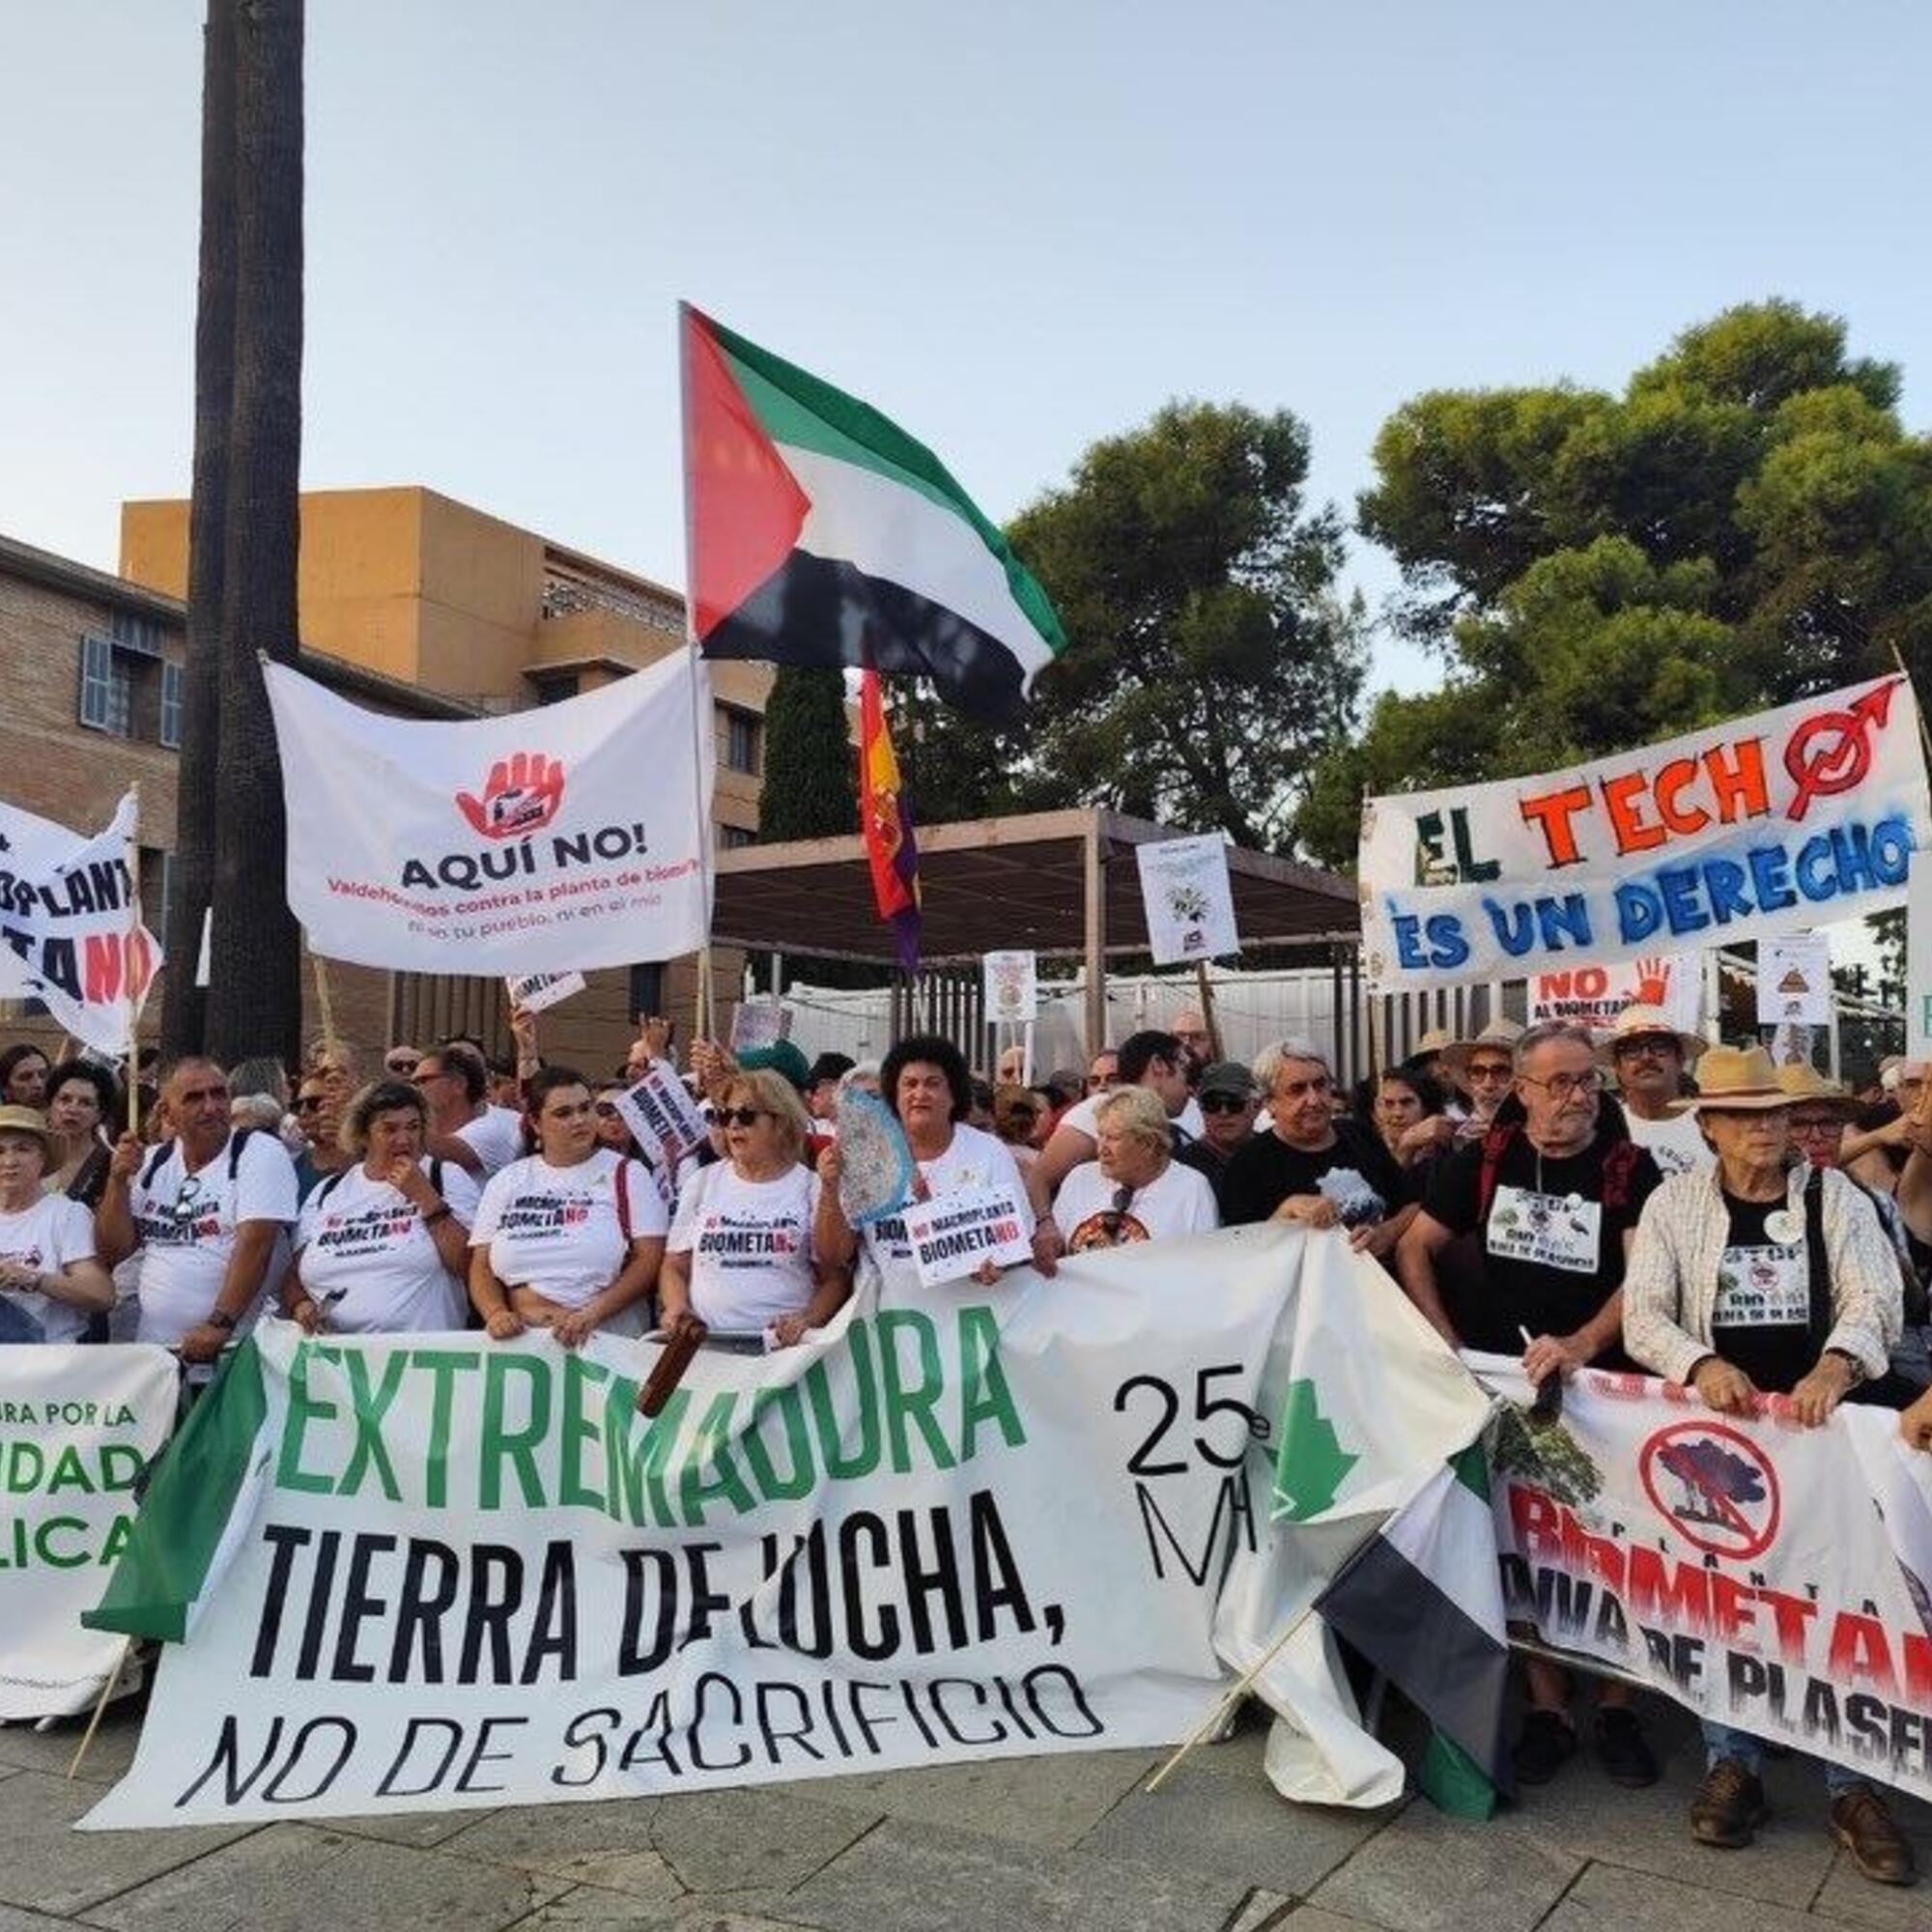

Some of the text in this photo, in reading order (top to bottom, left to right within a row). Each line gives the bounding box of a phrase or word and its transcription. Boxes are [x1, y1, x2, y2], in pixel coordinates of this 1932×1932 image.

[401, 823, 648, 890] AQUÍ NO!
[1415, 807, 1500, 887] EL
[455, 892, 521, 915] contra
[526, 889, 544, 903] la
[550, 876, 611, 900] planta
[616, 872, 641, 887] de
[1388, 816, 1914, 970] ES UN DERECHO
[1540, 967, 1608, 1001] NO
[920, 1221, 1020, 1264] BIOMETANO
[0, 1403, 136, 1427] RA POR LA
[275, 1305, 1027, 1527] EXTREMADURA
[250, 1523, 577, 1685] TIERRA
[619, 1542, 732, 1677] DE
[175, 1662, 1105, 1807] NO DE SACRIFICIO
